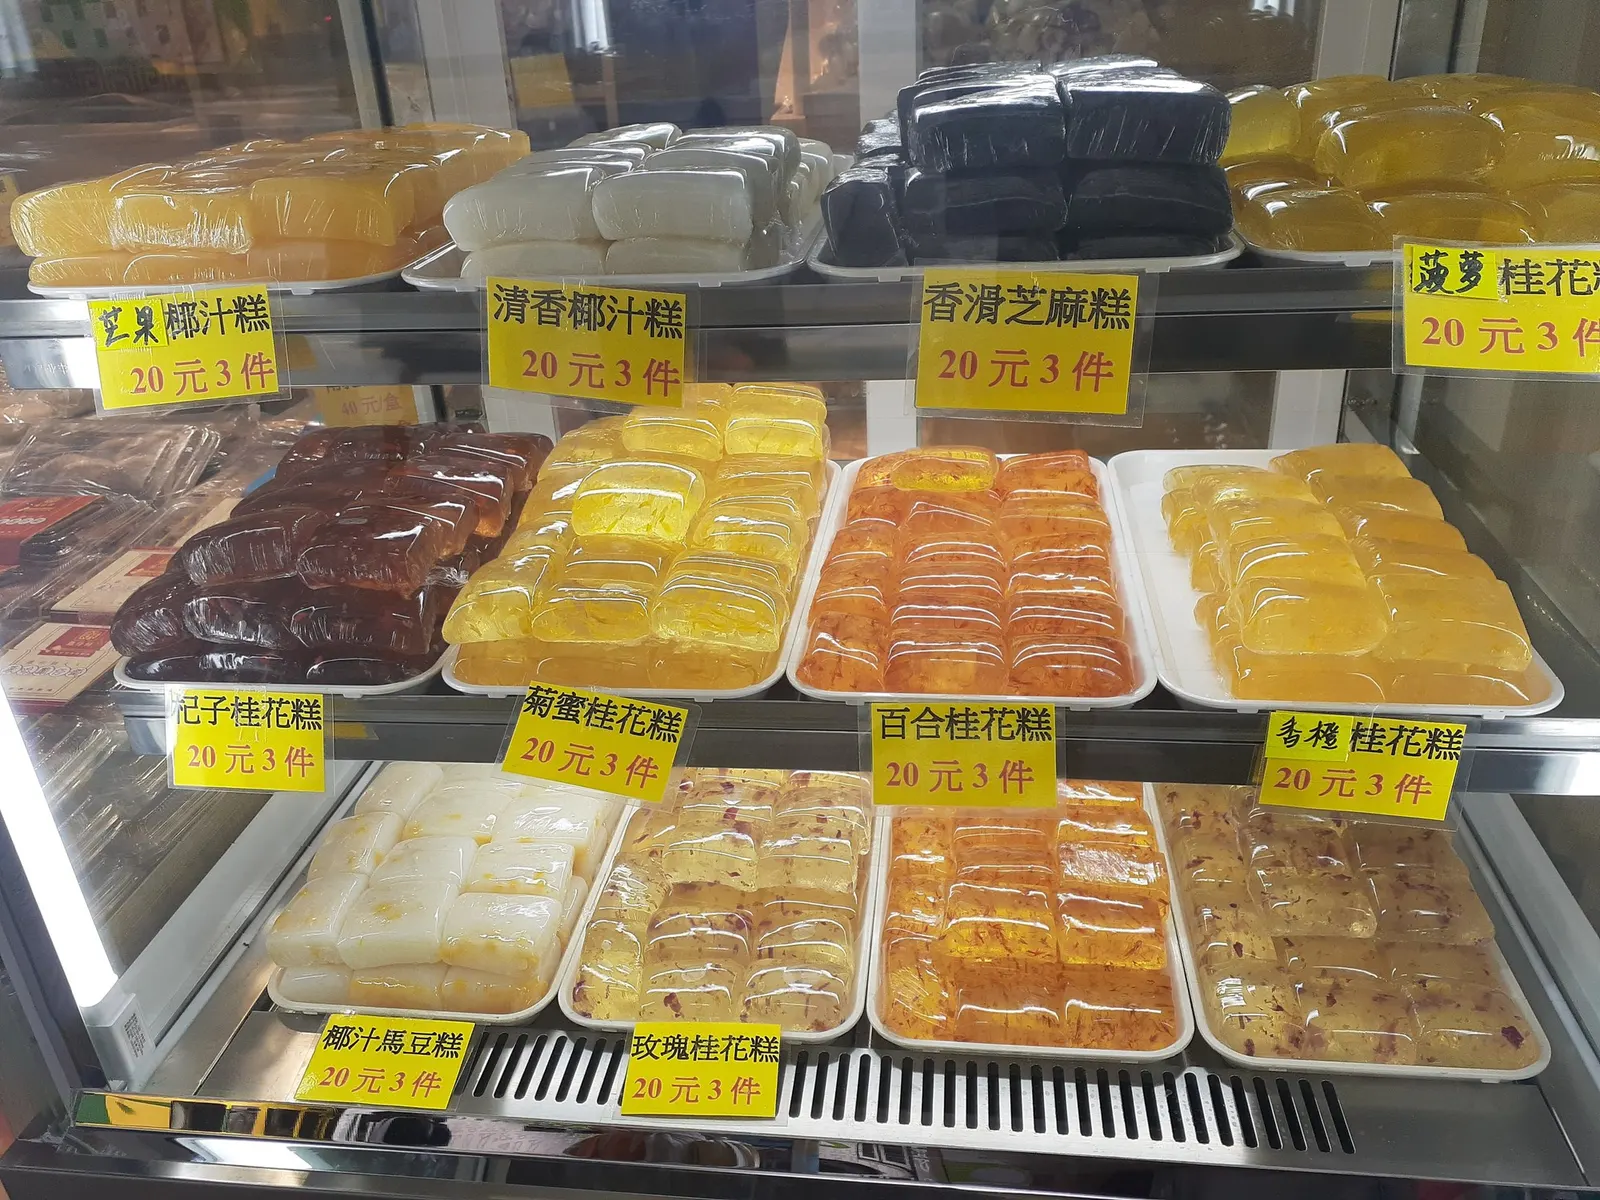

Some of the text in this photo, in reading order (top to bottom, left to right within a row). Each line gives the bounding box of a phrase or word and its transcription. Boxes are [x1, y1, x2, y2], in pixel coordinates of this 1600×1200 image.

[1414, 250, 1600, 296] 菠萝桂花
[493, 283, 683, 339] 清香椰汁糕
[924, 282, 1131, 329] 香滑芝麻糕
[172, 695, 322, 730] 杞子桂花糕
[523, 686, 682, 743] 菊蜜桂花糕
[876, 706, 1052, 742] 百合桂花糕
[1276, 716, 1464, 760] 香橙桂花糕
[322, 1025, 464, 1058] 椰汁馬豆糕
[631, 1034, 780, 1063] 玫瑰桂花糕
